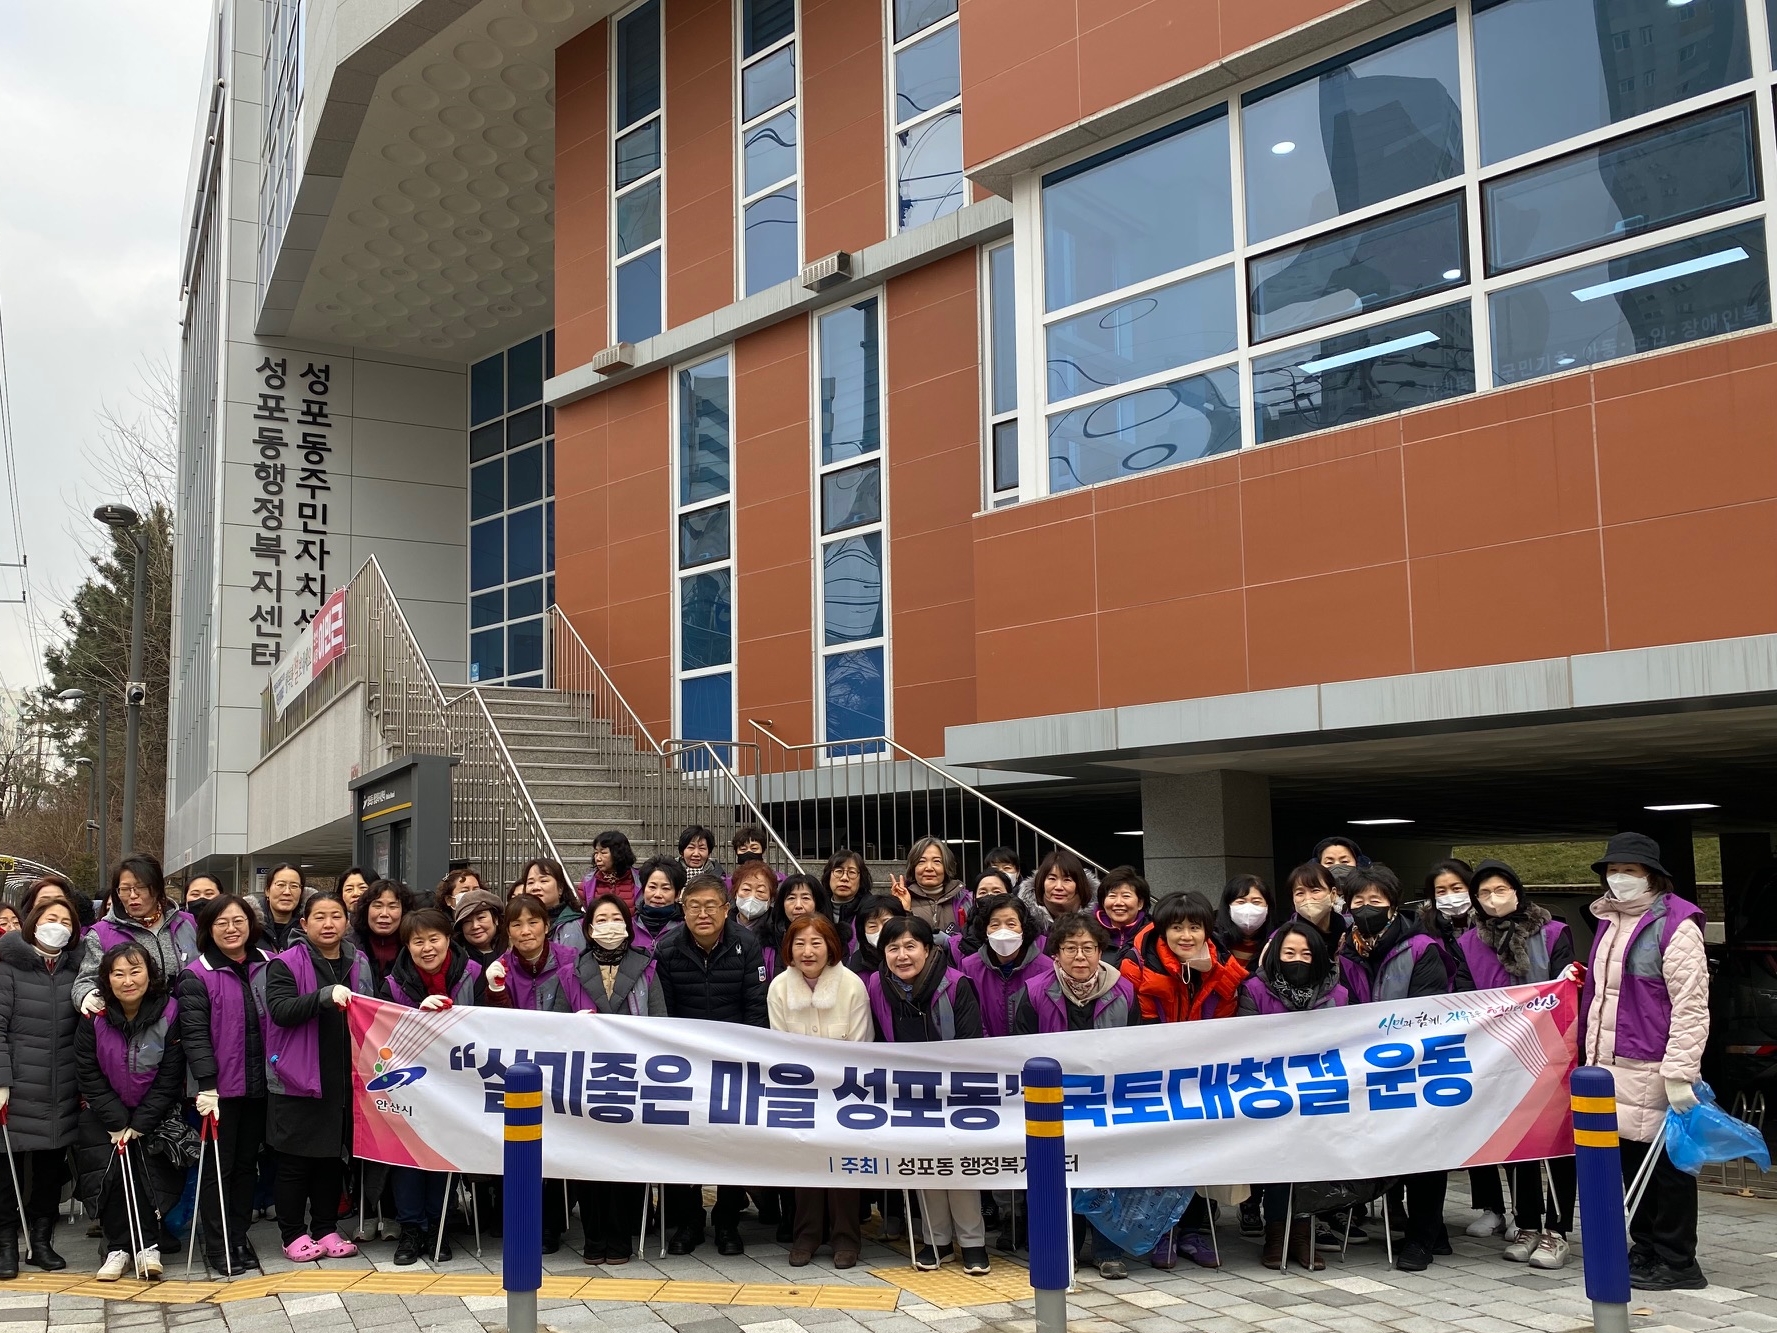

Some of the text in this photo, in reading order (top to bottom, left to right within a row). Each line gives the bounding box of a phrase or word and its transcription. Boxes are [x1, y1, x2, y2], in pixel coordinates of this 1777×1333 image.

[249, 356, 289, 667] 성포동행정복지센터
[1378, 1013, 1413, 1036] 시민과
[1526, 993, 1558, 1011] 안산
[708, 1059, 820, 1129] 마을
[1062, 1048, 1350, 1128] 국토대청결
[1363, 1033, 1473, 1111] 운동
[375, 1098, 414, 1117] 안산시
[841, 1155, 1079, 1176] 주최 성포동 행정복터
